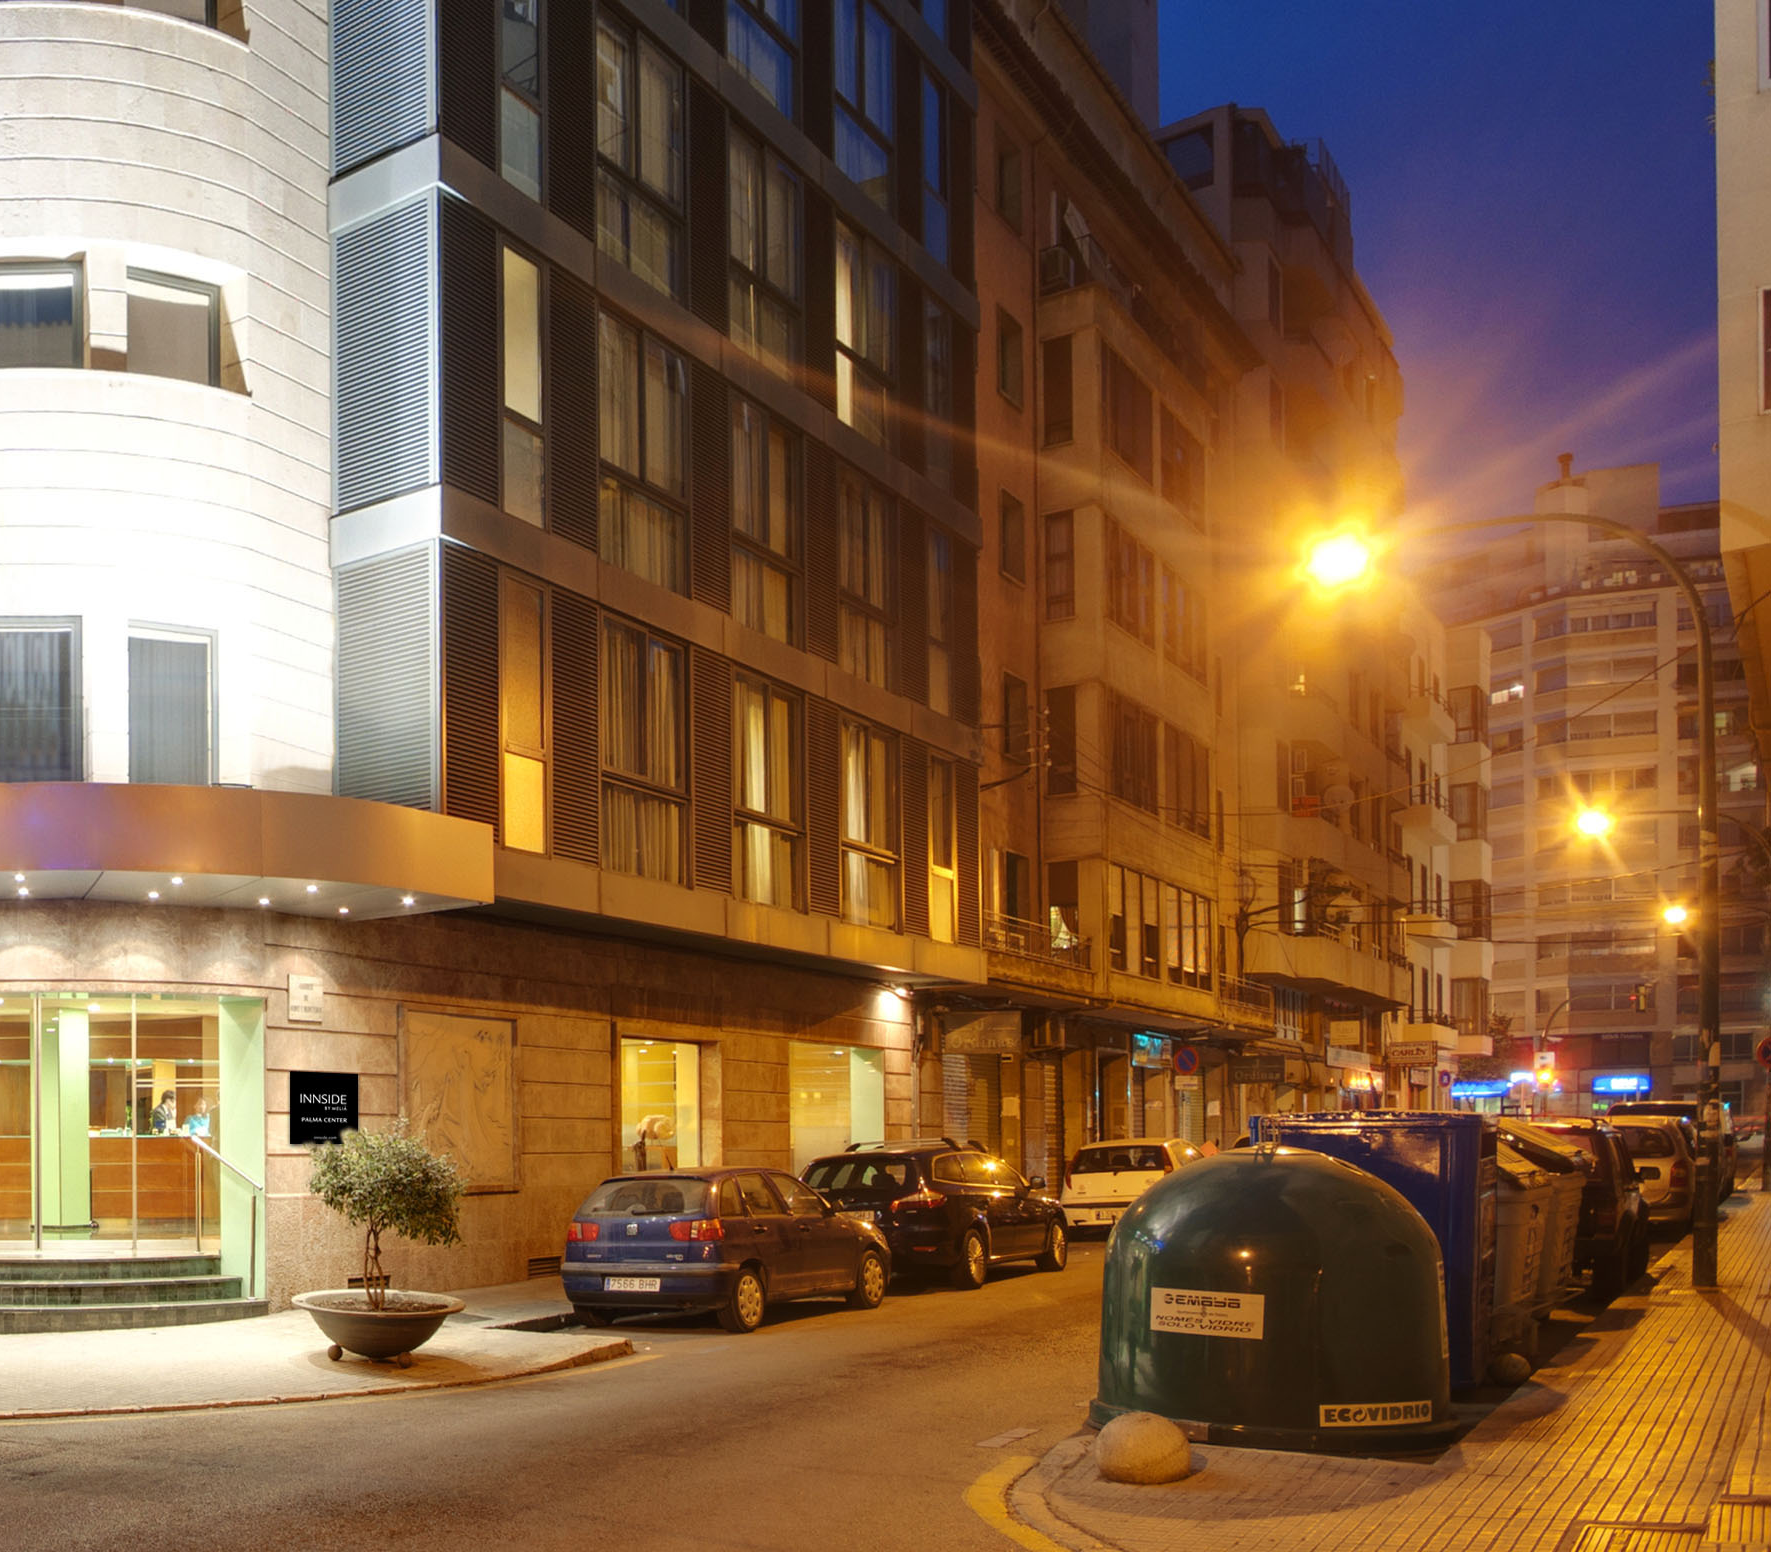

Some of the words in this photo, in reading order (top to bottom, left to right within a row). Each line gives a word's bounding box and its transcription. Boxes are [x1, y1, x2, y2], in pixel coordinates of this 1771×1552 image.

[299, 1093, 348, 1105] INNSIDE
[611, 1278, 635, 1289] 7566
[1199, 1324, 1252, 1333] VIDRIO
[1208, 1318, 1256, 1328] VIDRE
[1324, 1404, 1430, 1423] ECOVIDRIO
